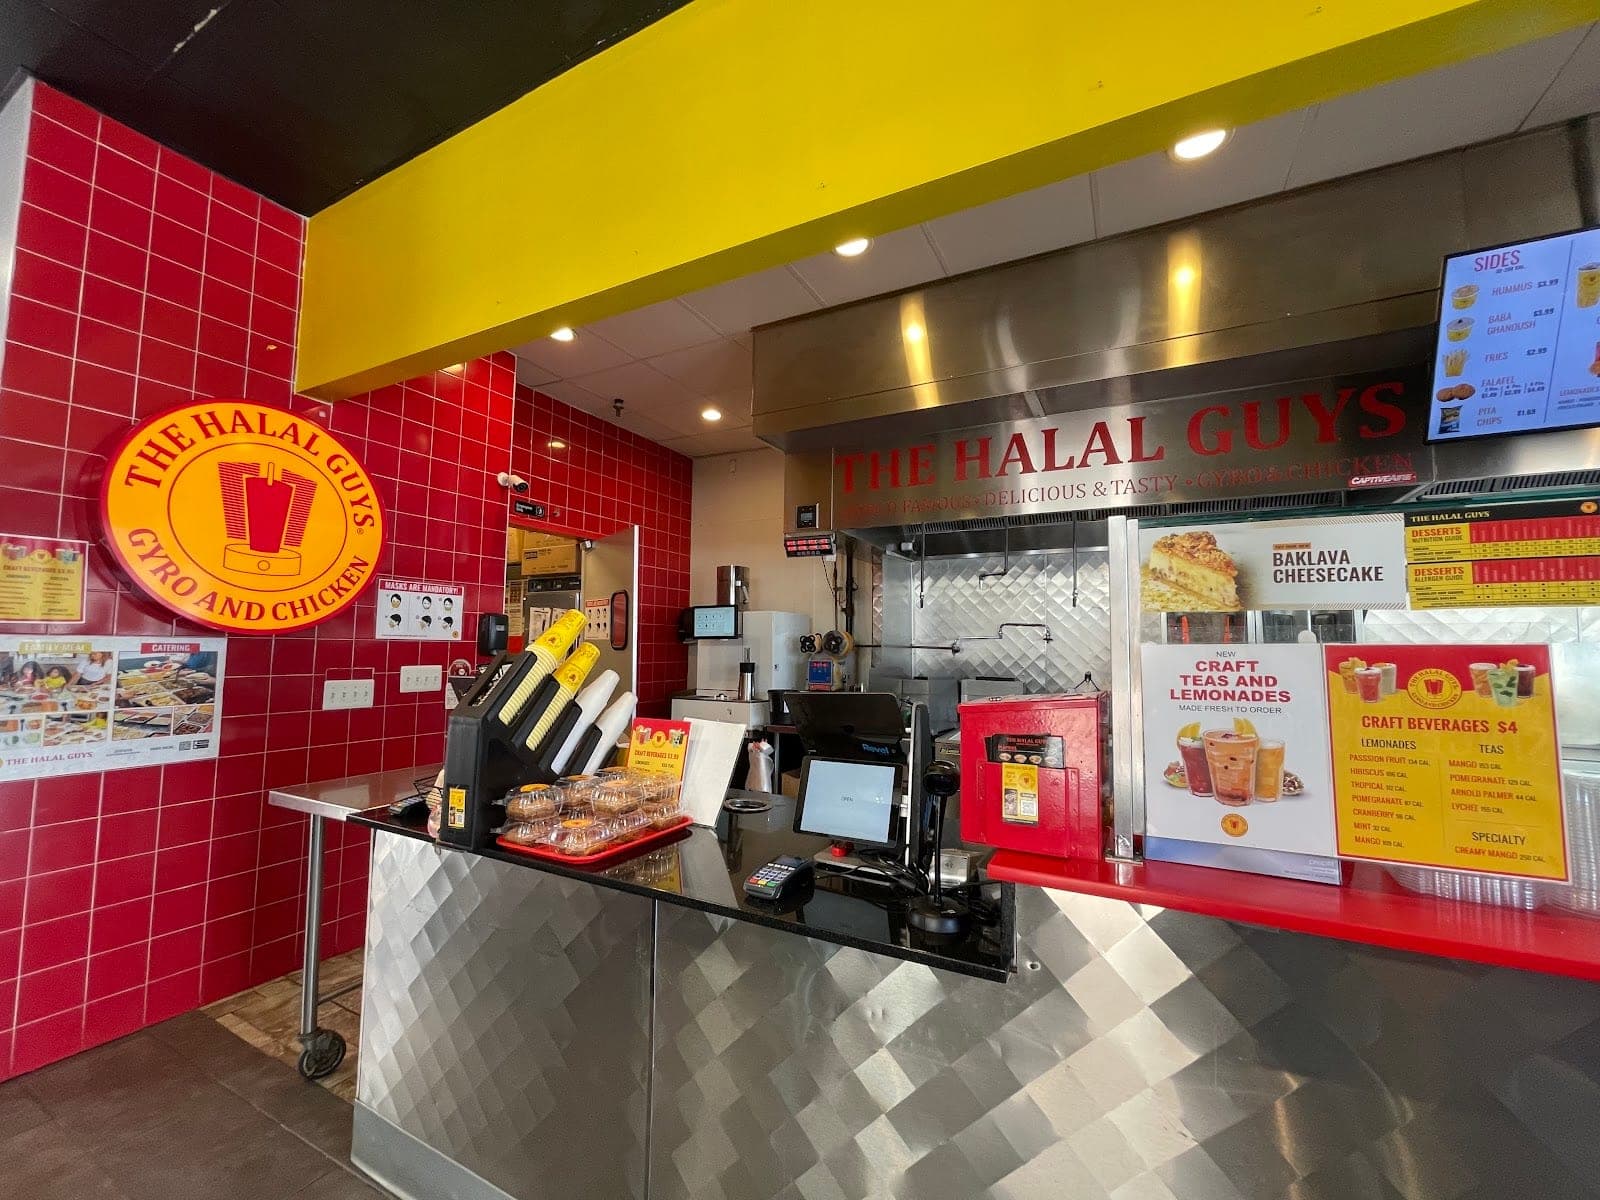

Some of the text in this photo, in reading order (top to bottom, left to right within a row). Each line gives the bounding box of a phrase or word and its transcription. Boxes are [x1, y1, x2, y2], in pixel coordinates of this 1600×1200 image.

[1474, 250, 1520, 272] SIDES
[1492, 282, 1533, 296] HUMMUS
[1488, 312, 1511, 324] BABA
[1487, 320, 1536, 335] GHANOUSH
[1485, 352, 1508, 363] FRIES
[1481, 376, 1515, 387] FALAFEL
[1477, 416, 1503, 427] CHIPS
[835, 381, 1407, 494] THE HALAL GUYS
[124, 409, 375, 530] THE HALAL GUYS
[985, 483, 1086, 507] DELICIOUS
[1092, 481, 1108, 498] &
[1110, 474, 1177, 497] TASTY
[1431, 512, 1463, 521] HALAL
[1464, 511, 1490, 519] GUYS
[1411, 526, 1461, 538] DESSERTS
[1273, 549, 1351, 567] BAKLAVA
[127, 528, 369, 621] GYRO AND CHICKEN
[1273, 566, 1384, 584] CHEESECAKE
[1414, 566, 1464, 577] DESSERTS
[385, 582, 459, 594] MASKS ARE MANDATORY!
[152, 644, 191, 652] CATERING
[1195, 660, 1259, 672] CRAFT
[1180, 675, 1278, 687] TEAS AND
[1170, 689, 1291, 703] LEMONADES
[1179, 704, 1202, 712] MADE
[1362, 715, 1518, 734] CRAFT BEVERAGES $4
[1361, 738, 1416, 750] LEMONADES
[1479, 744, 1504, 754] TEAS
[7, 751, 94, 765] THE HALAL GUYS
[1385, 756, 1407, 764] FRUIT
[1449, 760, 1477, 769] MANGO
[1350, 768, 1384, 777] HIBISCUS
[1351, 781, 1384, 790] TROPICAL
[1450, 774, 1505, 785] POMEGRANATE
[1352, 794, 1403, 805] POMEGRANATE
[1451, 788, 1481, 798] ARNOLD
[1483, 791, 1513, 800] PALMER
[1353, 808, 1394, 818] CRANBERRY
[1452, 803, 1479, 812] LYCHEE
[1353, 822, 1372, 830] MINT
[1354, 835, 1381, 845] MANGO
[1472, 831, 1525, 845] SPECIALTY
[1455, 846, 1486, 856] CREAMY
[1488, 848, 1518, 860] MANGO
